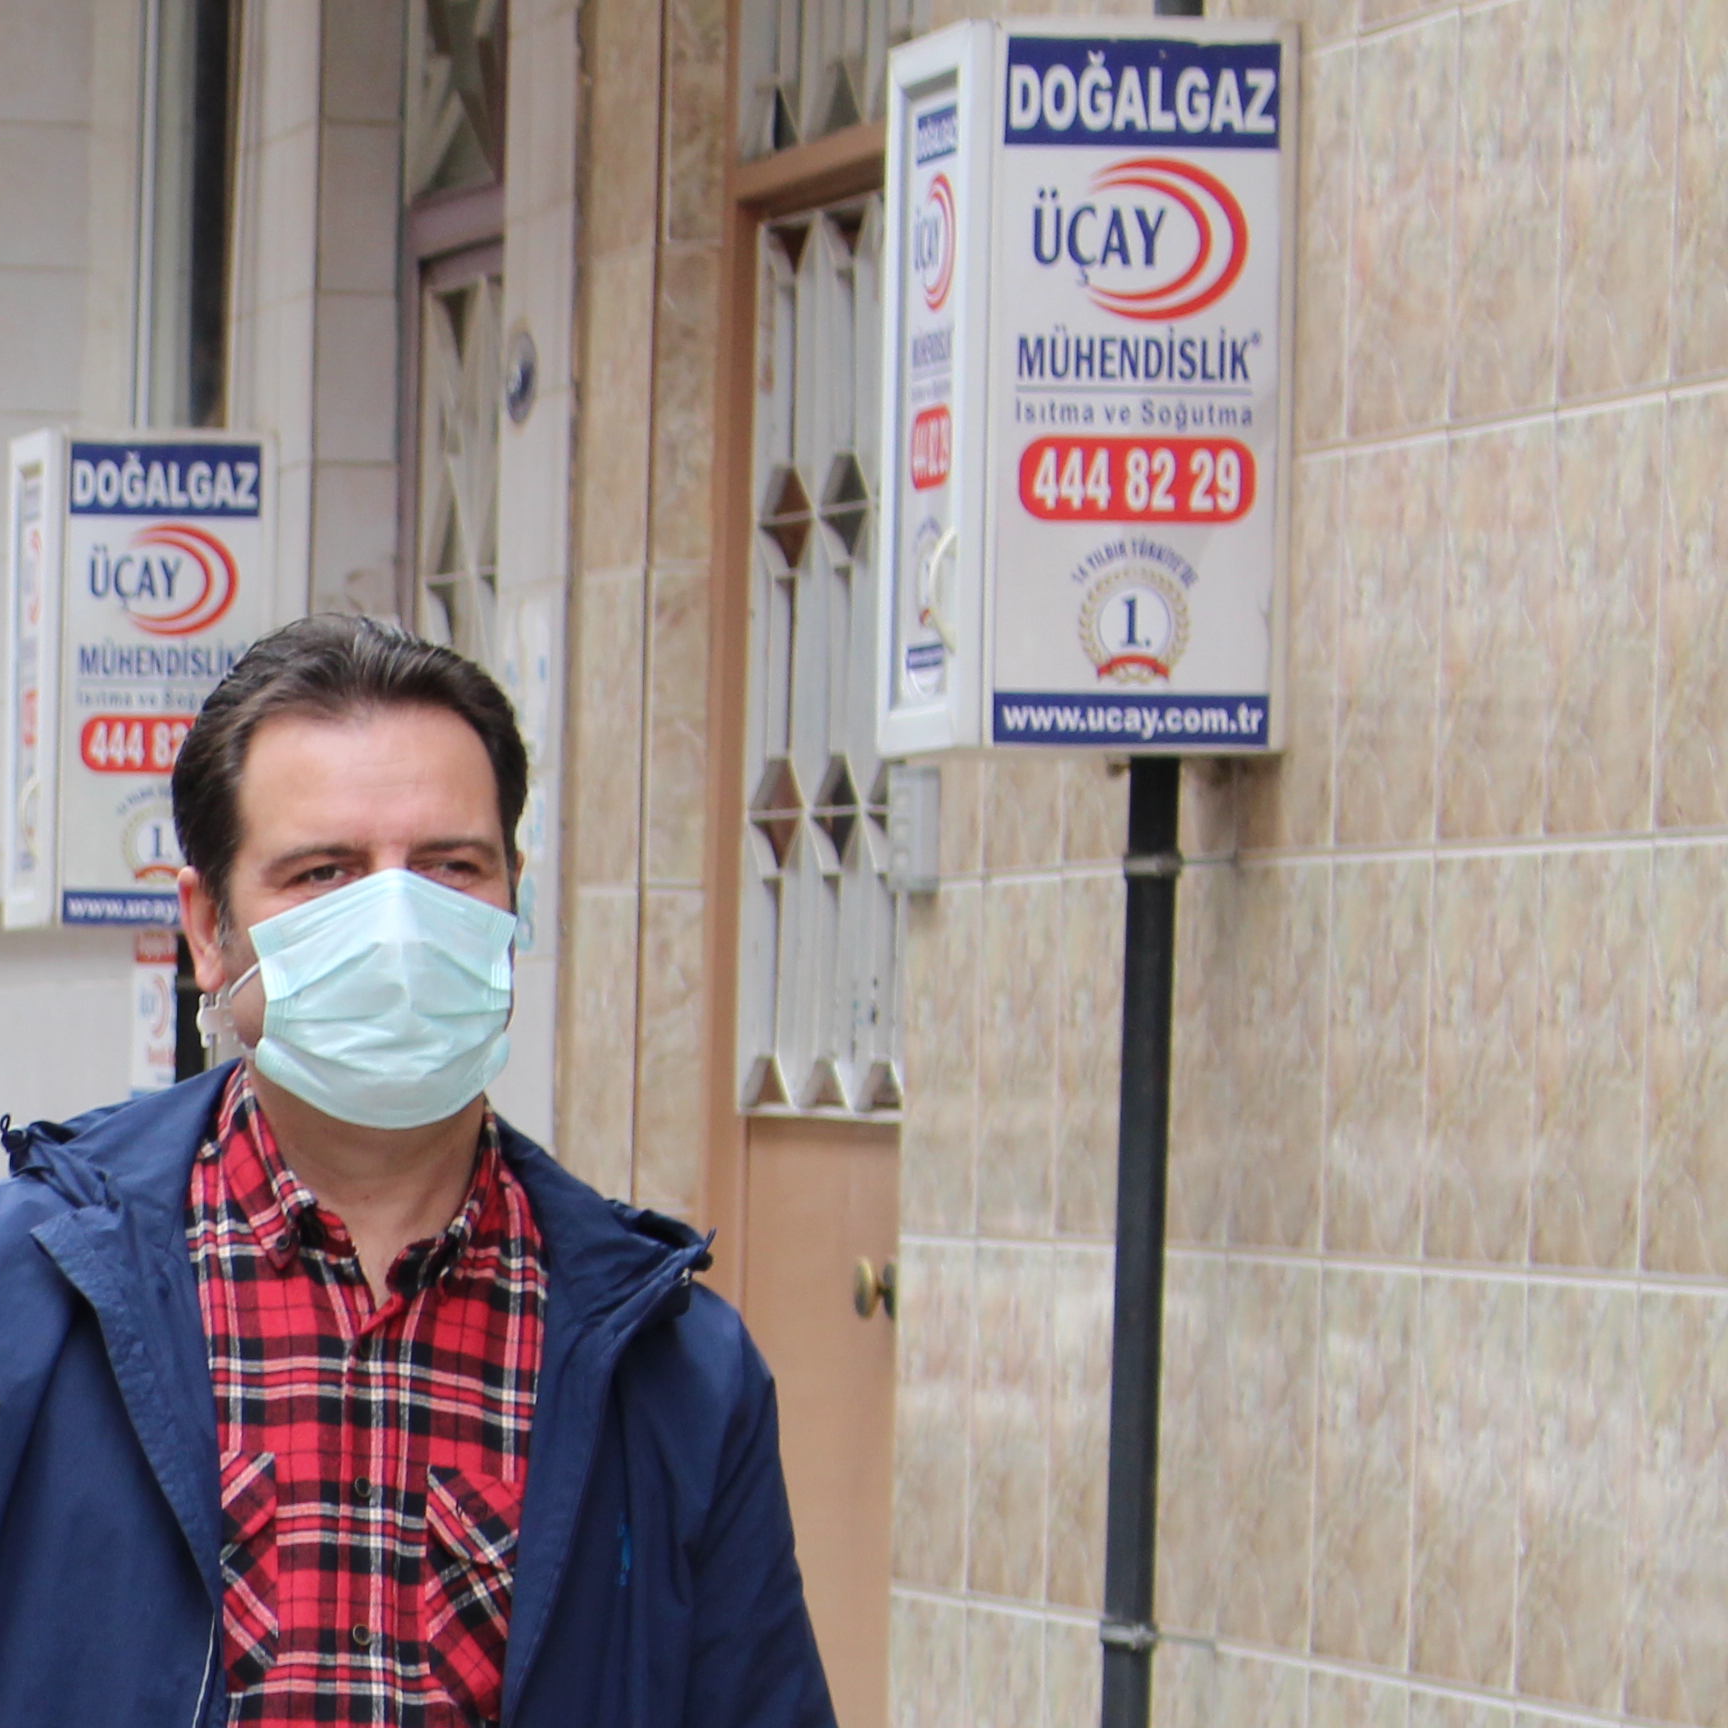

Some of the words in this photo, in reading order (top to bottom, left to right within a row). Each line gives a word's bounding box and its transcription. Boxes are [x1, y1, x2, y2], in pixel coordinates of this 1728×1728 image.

[1009, 49, 1276, 133] DOĞALGAZ
[1033, 187, 1167, 287] ÜÇAY
[1018, 323, 1250, 381] MÜHENDİSLİK
[1016, 398, 1094, 425] Isıtma
[1104, 404, 1131, 425] ve
[1142, 398, 1253, 433] Soğutma
[72, 450, 259, 509] DOĞALGAZ
[1033, 447, 1112, 511] 444
[1125, 447, 1176, 512] 82
[1189, 448, 1242, 513] 29
[89, 544, 182, 611] ÜÇAY
[89, 721, 145, 767] 444
[1002, 703, 1264, 740] www.ucay.com.tr
[67, 898, 179, 924] www.ucay
